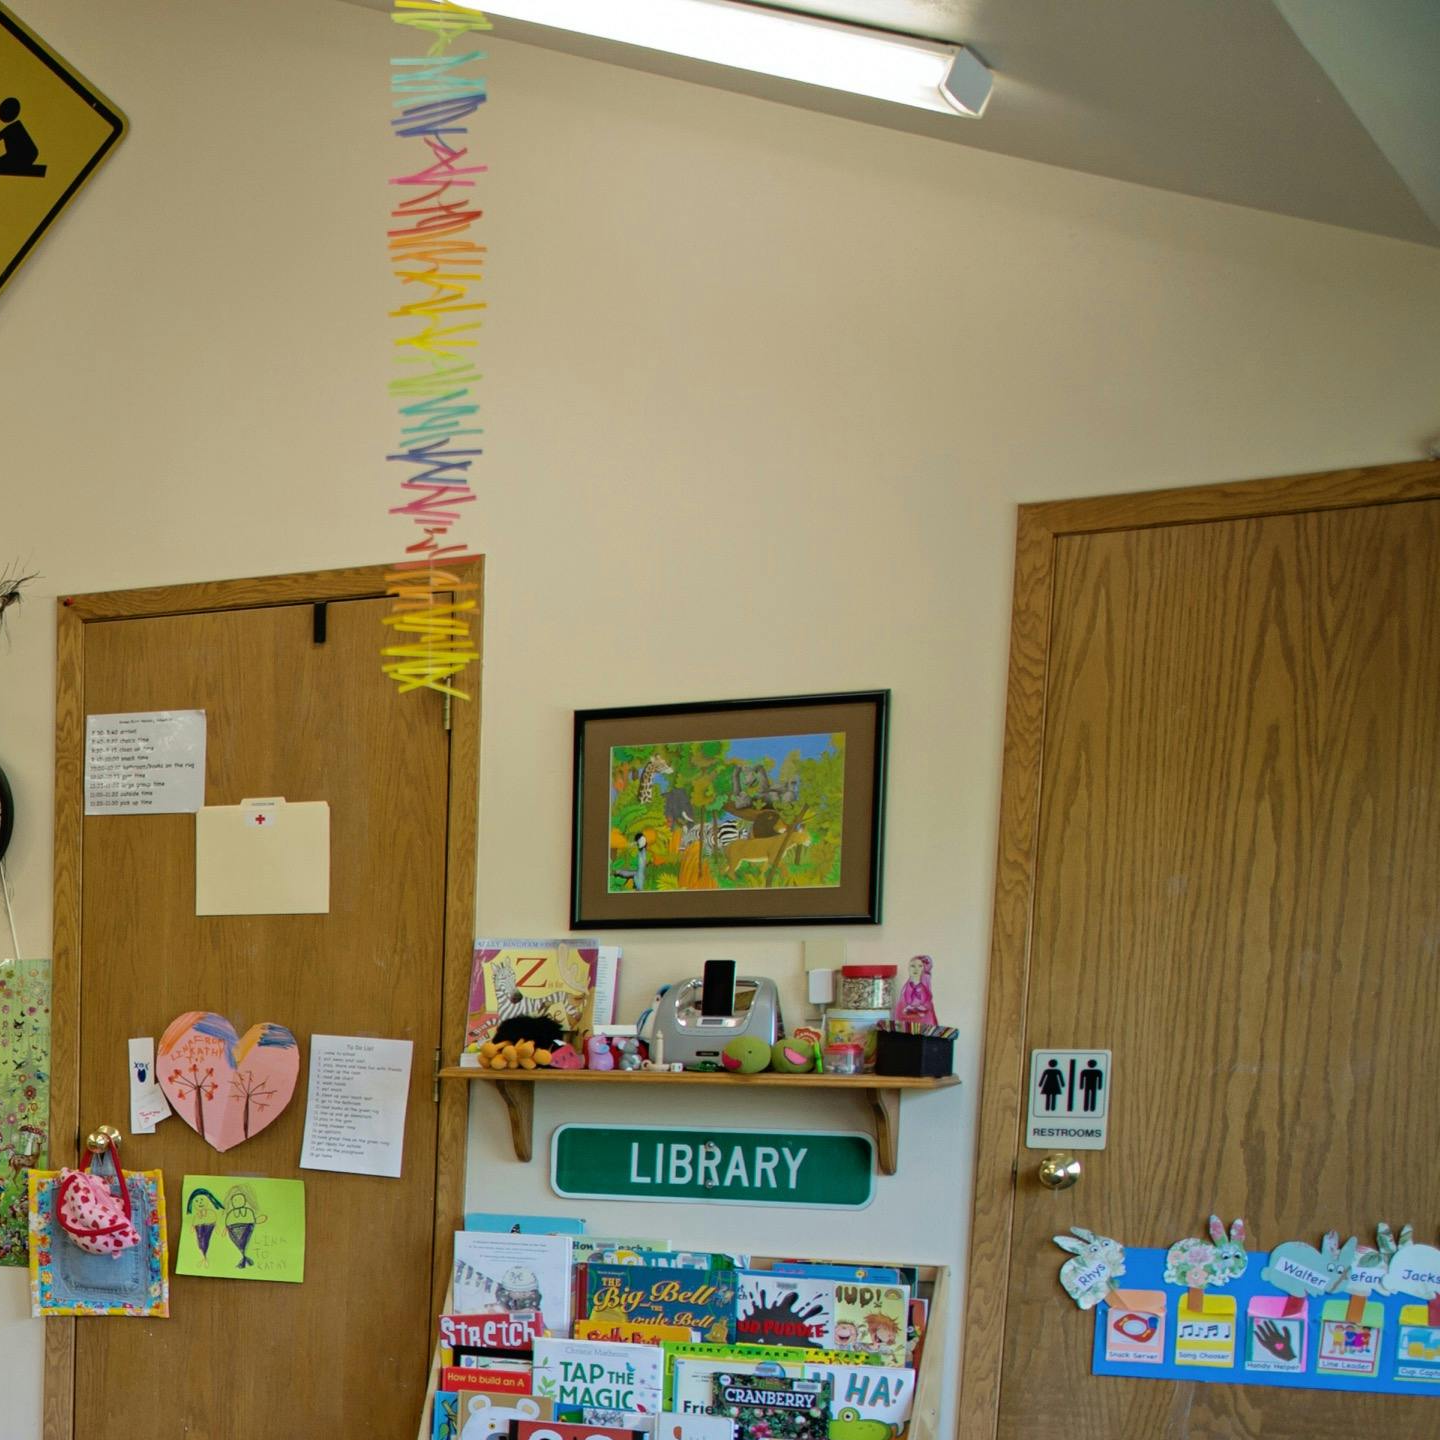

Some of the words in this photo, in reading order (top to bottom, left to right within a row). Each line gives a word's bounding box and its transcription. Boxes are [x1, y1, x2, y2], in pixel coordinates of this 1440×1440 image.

[515, 957, 548, 988] Z
[1033, 1128, 1102, 1137] RESTROOMS
[630, 1142, 808, 1189] LIBRARY
[601, 1277, 622, 1287] THE
[1078, 1263, 1106, 1286] Rhys
[1283, 1261, 1326, 1287] Walter
[1350, 1272, 1381, 1284] efan
[593, 1286, 645, 1313] Big
[649, 1280, 719, 1306] Bell
[737, 1320, 761, 1335] UD
[763, 1321, 825, 1338] PUDDLE
[447, 1372, 465, 1381] How
[466, 1374, 476, 1382] to
[478, 1374, 501, 1385] build
[503, 1378, 515, 1386] an
[560, 1361, 604, 1384] TAP
[607, 1371, 634, 1385] THE
[560, 1385, 634, 1410] MAGIC
[724, 1388, 816, 1409] CRANBERRY
[844, 1372, 904, 1407] HA!
[683, 1400, 713, 1415] Frie
